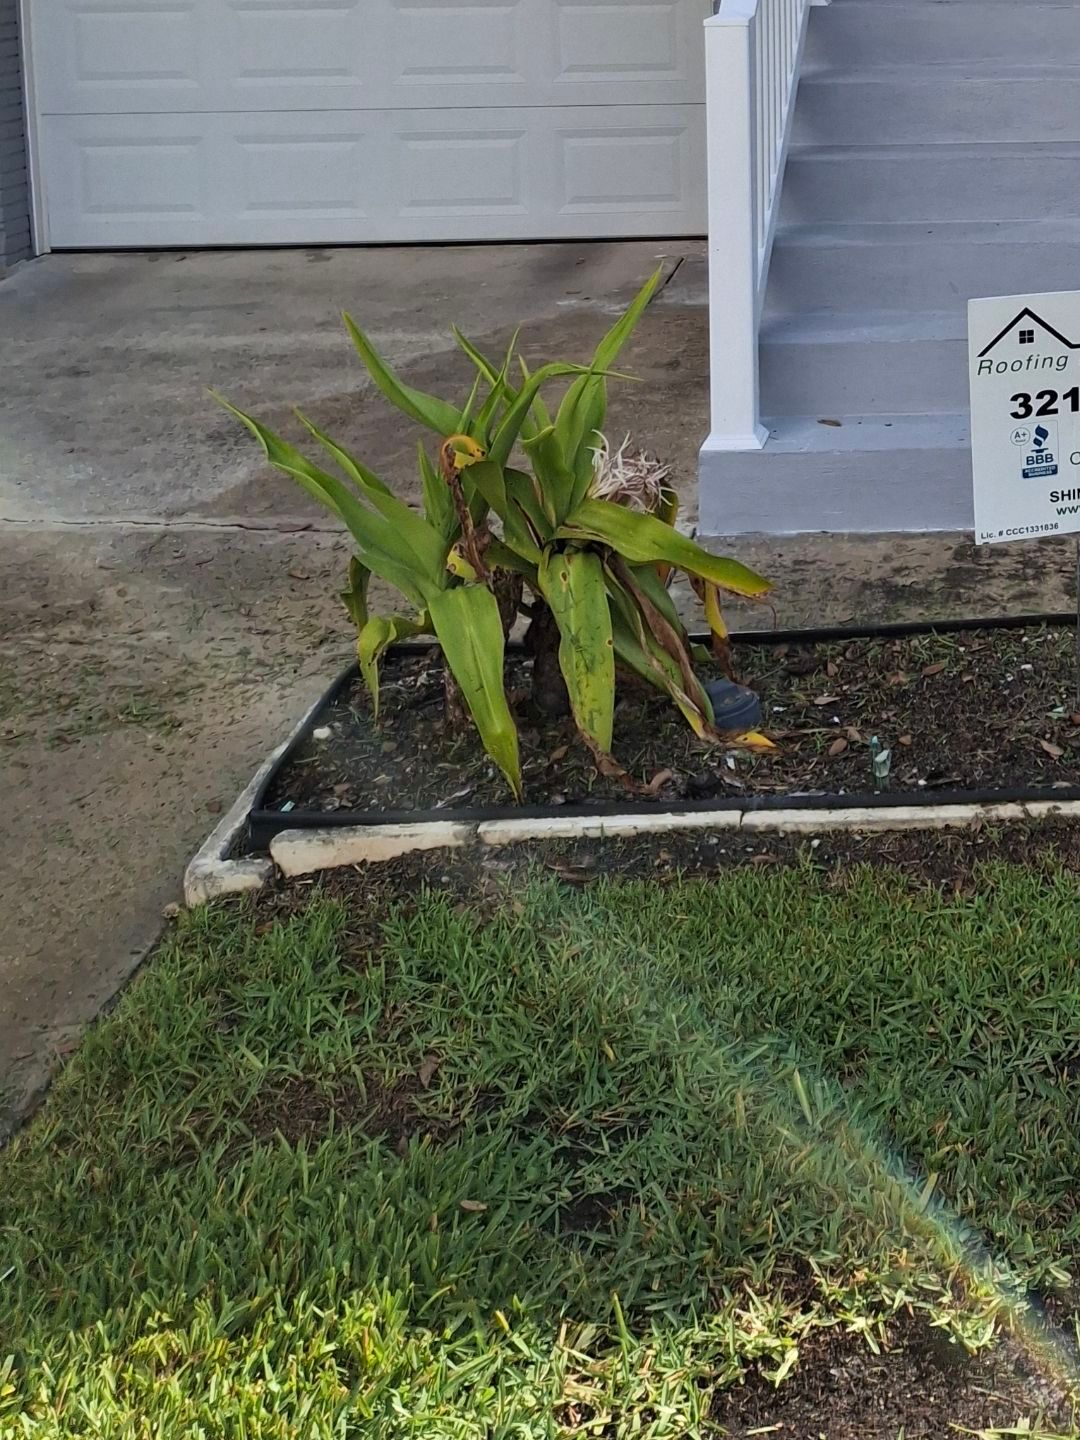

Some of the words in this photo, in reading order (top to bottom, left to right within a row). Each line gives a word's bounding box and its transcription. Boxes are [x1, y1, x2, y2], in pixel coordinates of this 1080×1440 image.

[976, 353, 1069, 376] Roofing
[1014, 431, 1028, 440] A+
[1026, 453, 1054, 466] BBB
[980, 531, 996, 540] Lic.
[998, 529, 1004, 537] #
